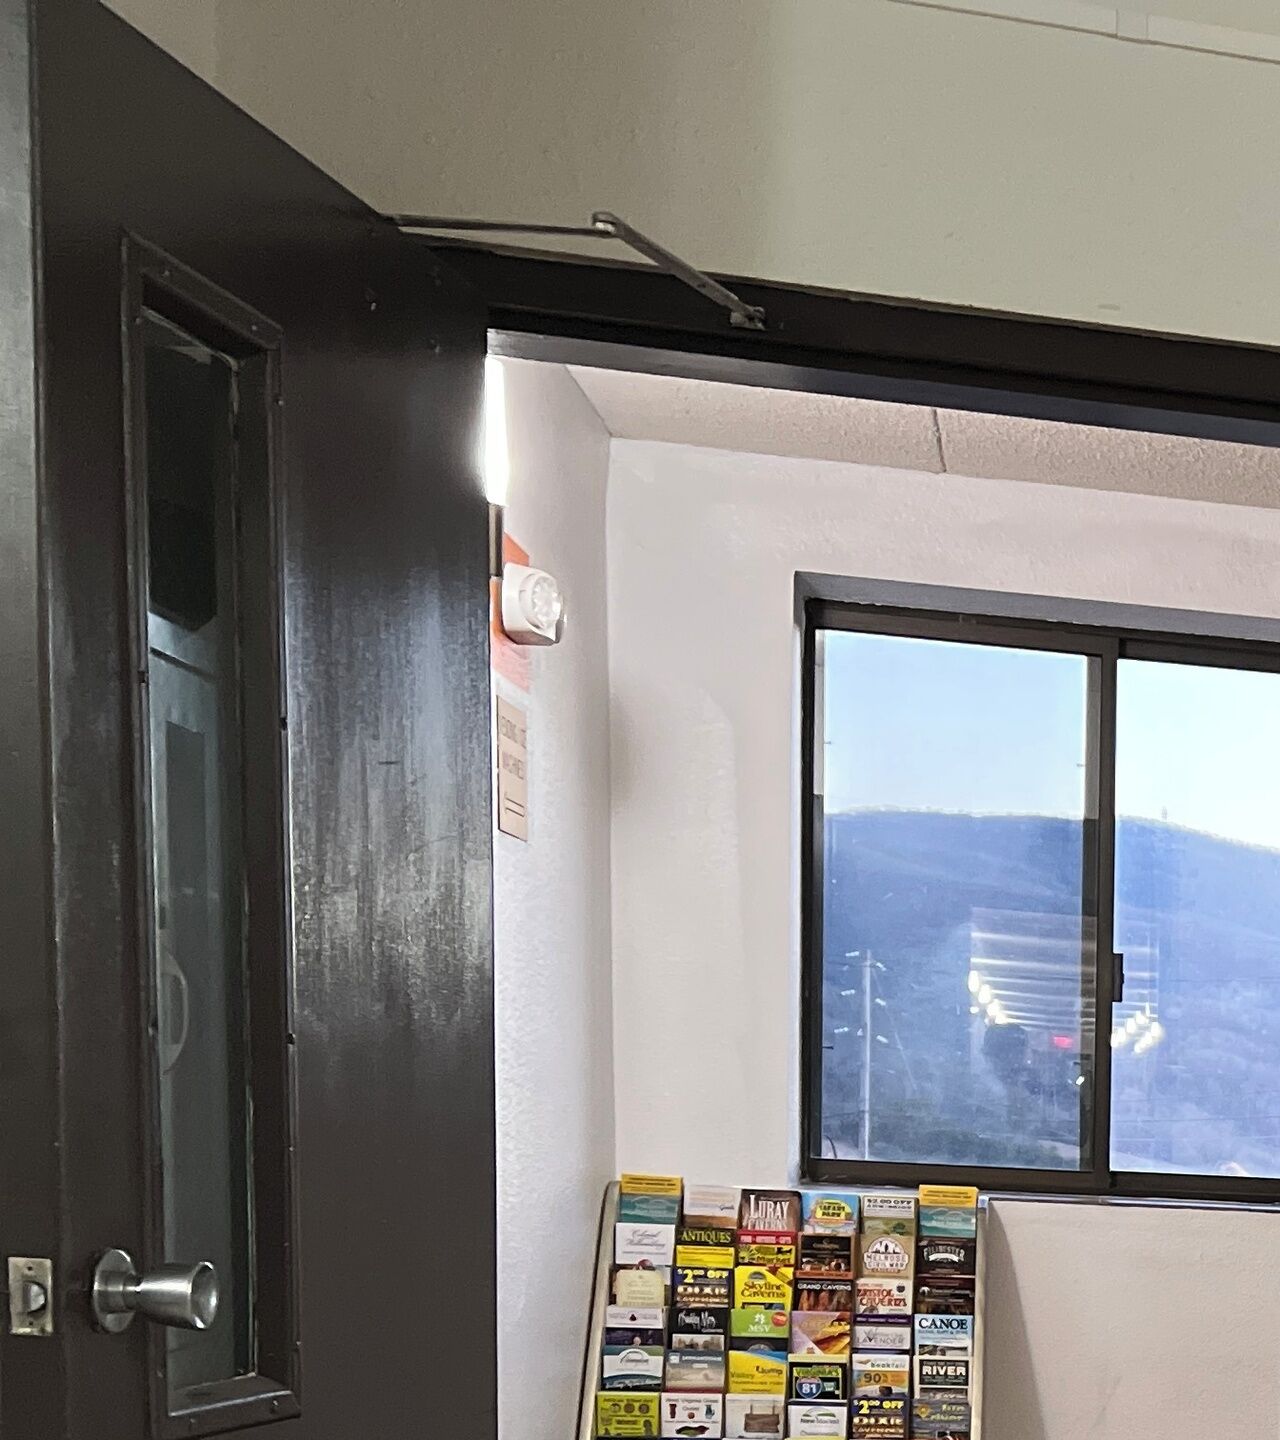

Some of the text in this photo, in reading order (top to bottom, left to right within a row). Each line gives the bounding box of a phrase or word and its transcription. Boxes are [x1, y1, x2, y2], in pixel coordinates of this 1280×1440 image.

[681, 1230, 731, 1243] ANTIQUES
[706, 1269, 729, 1279] OFF
[741, 1288, 786, 1298] Caverns
[918, 1317, 969, 1330] CANOE
[922, 1365, 966, 1376] RIVER
[801, 1383, 817, 1395] 81
[882, 1400, 904, 1409] OFF
